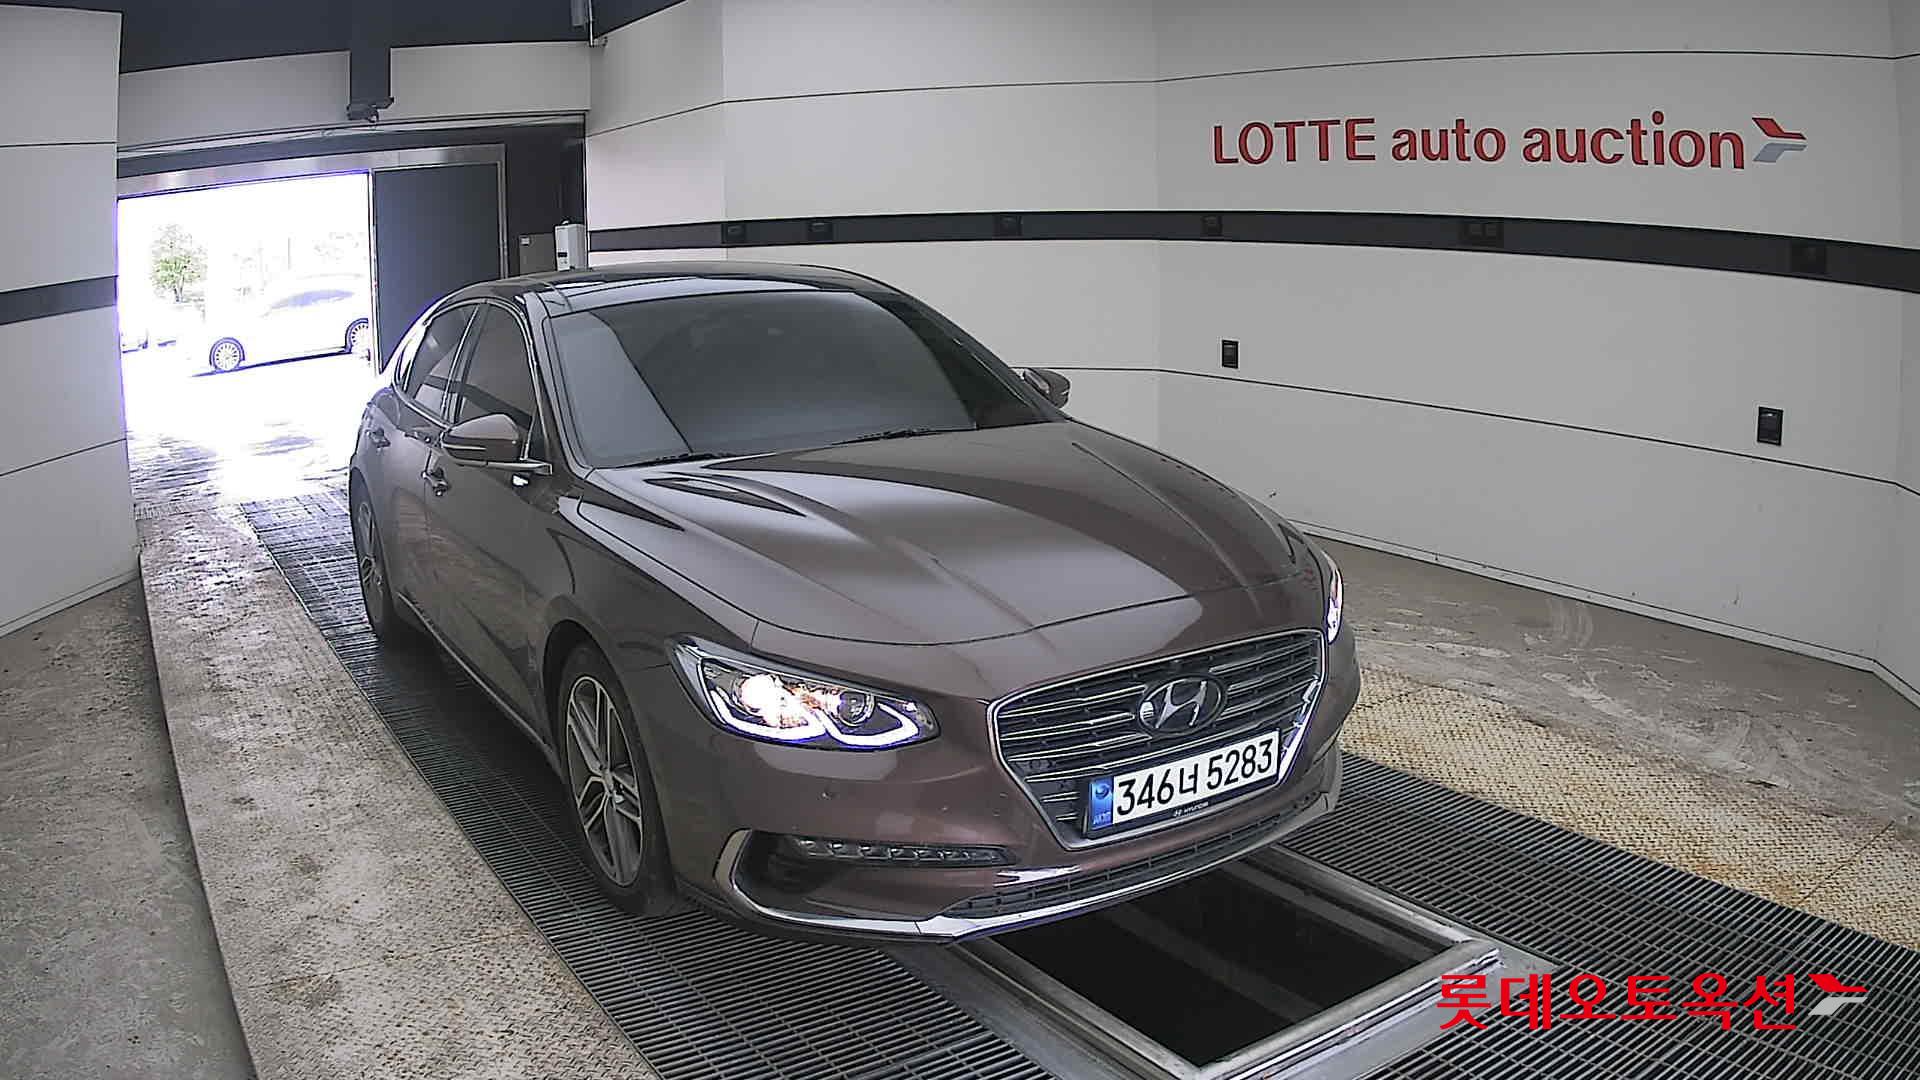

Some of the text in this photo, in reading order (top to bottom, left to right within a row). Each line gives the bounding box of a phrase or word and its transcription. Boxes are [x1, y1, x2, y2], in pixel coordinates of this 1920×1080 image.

[1213, 110, 1745, 170] LOTTE auto auction
[1116, 738, 1274, 816] 346너 5283
